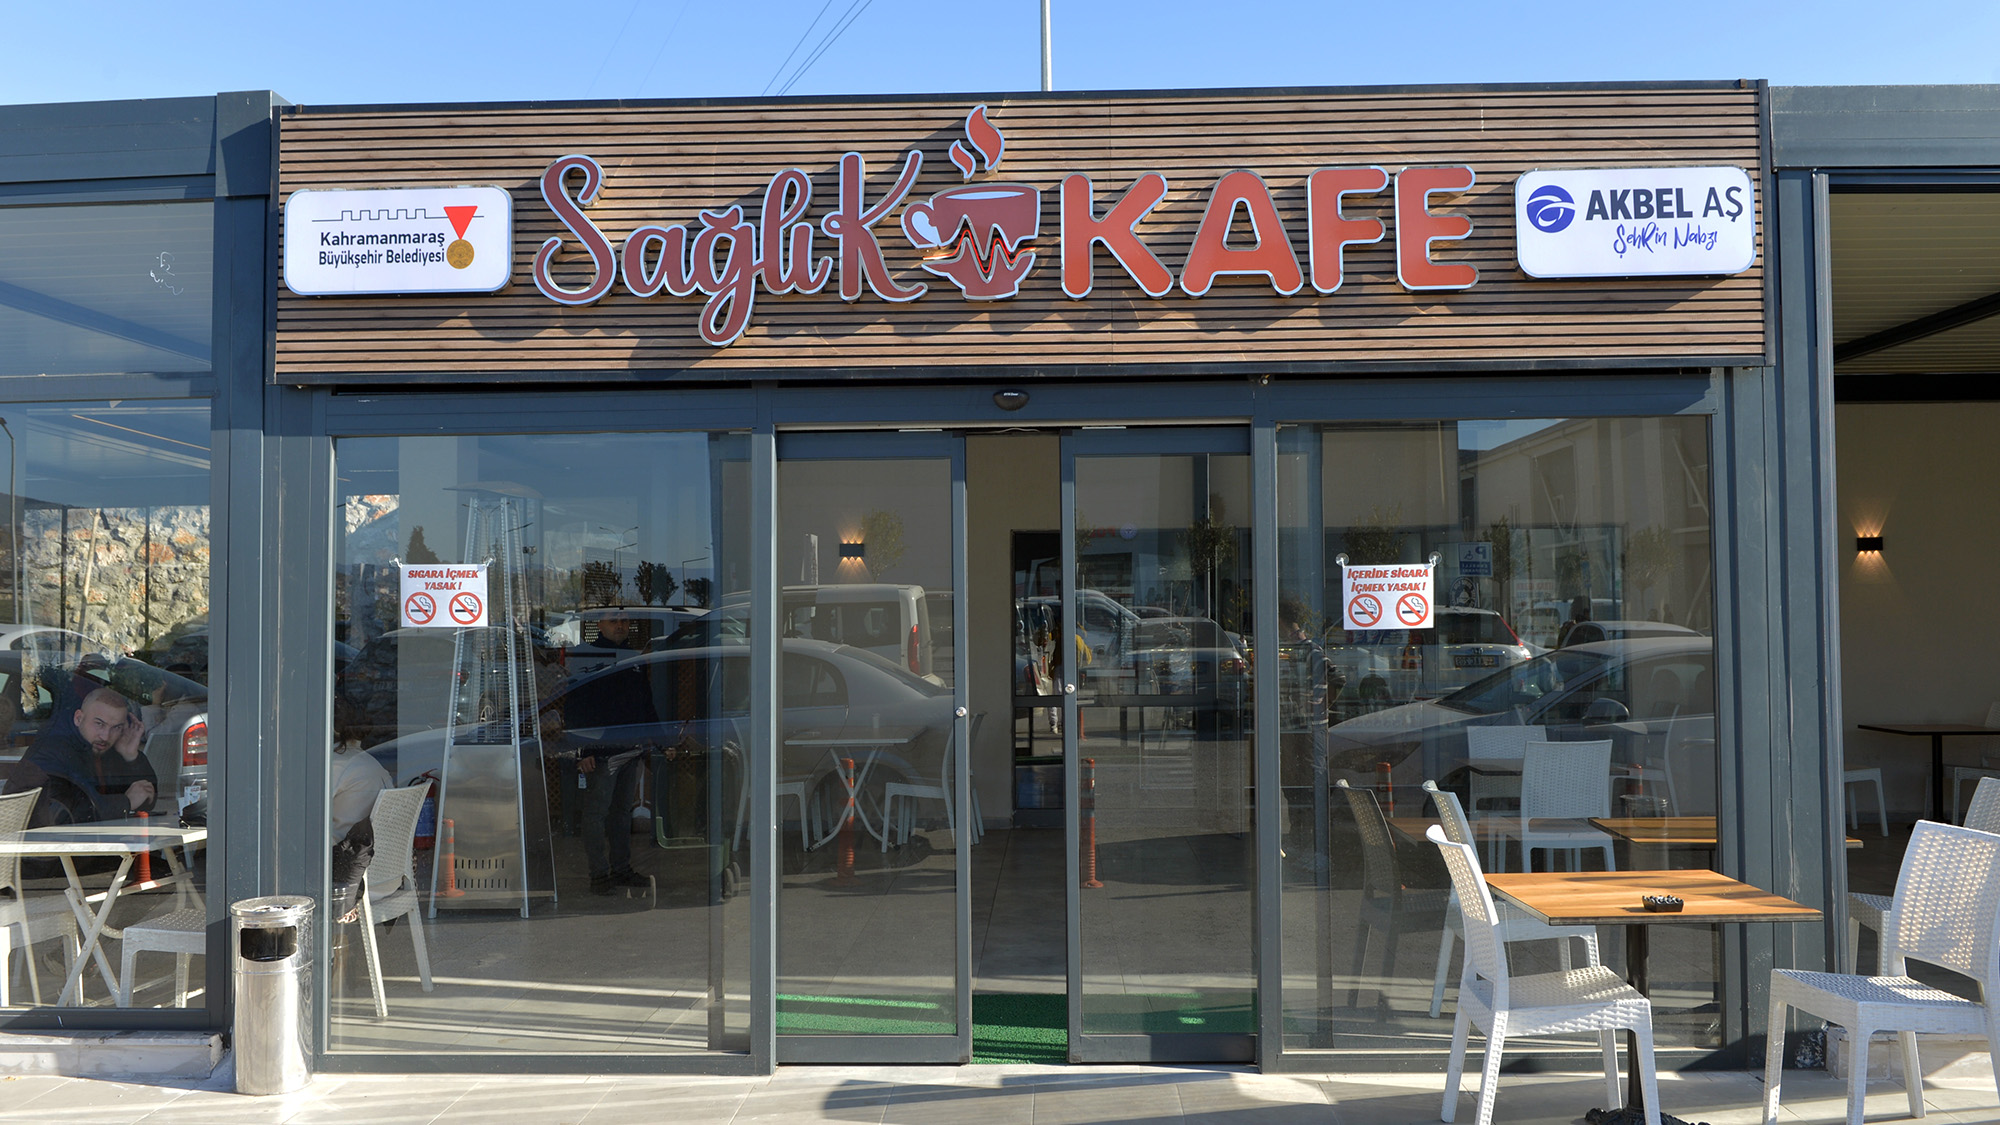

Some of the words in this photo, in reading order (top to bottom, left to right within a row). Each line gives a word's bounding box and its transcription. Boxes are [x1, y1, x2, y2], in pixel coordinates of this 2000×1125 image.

[1585, 187, 1694, 221] AKBEL
[1702, 185, 1744, 222] AŞ
[320, 231, 446, 247] Kahramanmaraş
[1060, 165, 1480, 300] KAFE
[1673, 222, 1718, 251] Nabzı
[318, 250, 383, 269] Büyükşehir
[386, 248, 445, 266] Belediyesi
[445, 568, 479, 580] İÇMEK
[1347, 567, 1389, 581] İÇERİDE
[1390, 567, 1429, 578] SİGARA
[424, 581, 457, 590] YASAK
[1351, 581, 1385, 594] İÇMEK
[1387, 582, 1421, 592] YASAK
